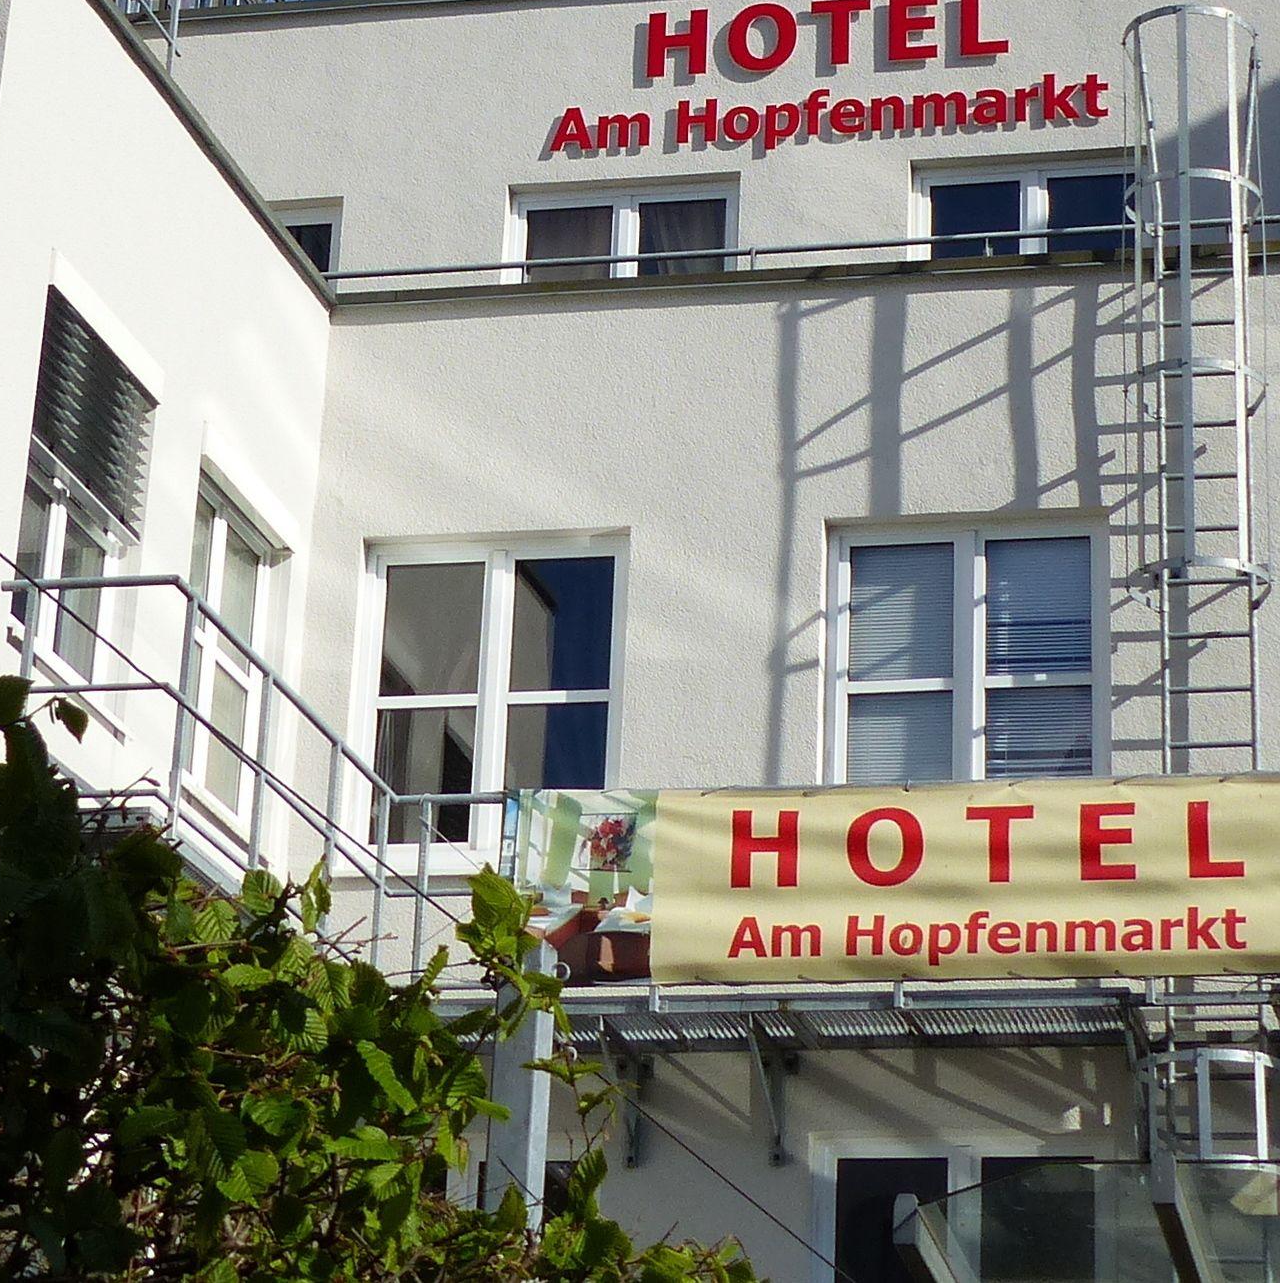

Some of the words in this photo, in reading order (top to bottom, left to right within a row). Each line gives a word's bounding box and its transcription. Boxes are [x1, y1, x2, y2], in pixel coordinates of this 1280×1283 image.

[549, 106, 650, 152] Am
[676, 73, 1109, 150] Hopfenmarkt
[729, 800, 1246, 889] HOTEL
[728, 916, 822, 959] Am
[845, 905, 1247, 965] Hopfenmarkt
